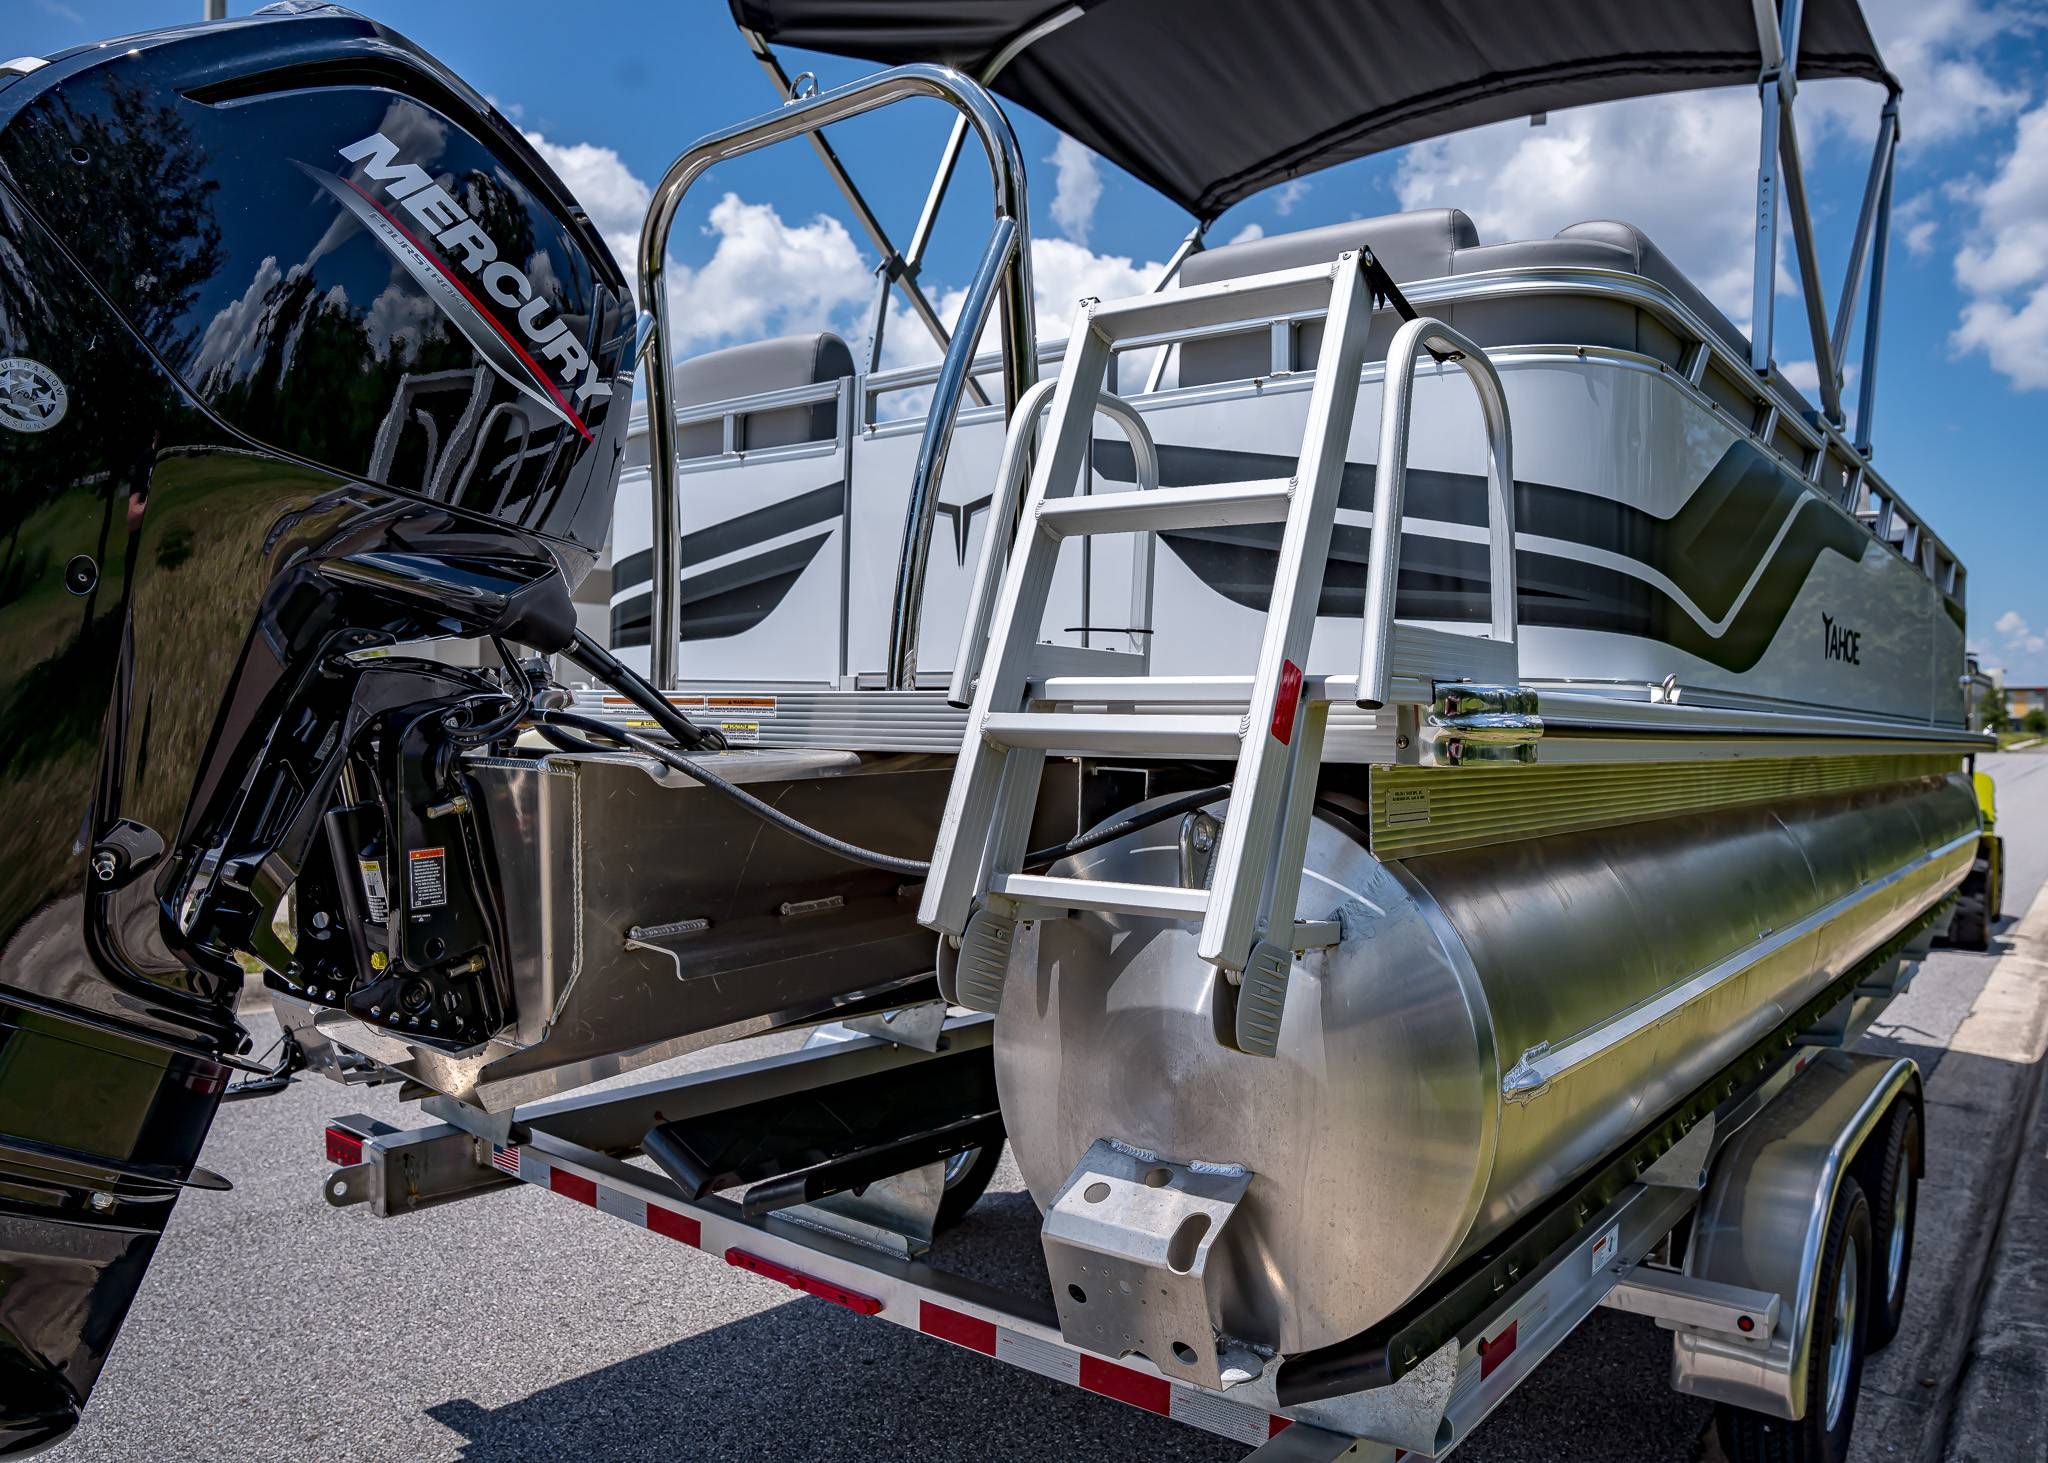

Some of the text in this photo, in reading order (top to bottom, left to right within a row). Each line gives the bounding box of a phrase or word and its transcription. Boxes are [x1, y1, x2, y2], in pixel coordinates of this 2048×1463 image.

[338, 132, 613, 401] MERCURY
[368, 211, 472, 312] FOURSTROKE
[1822, 610, 1861, 665] TAHOE
